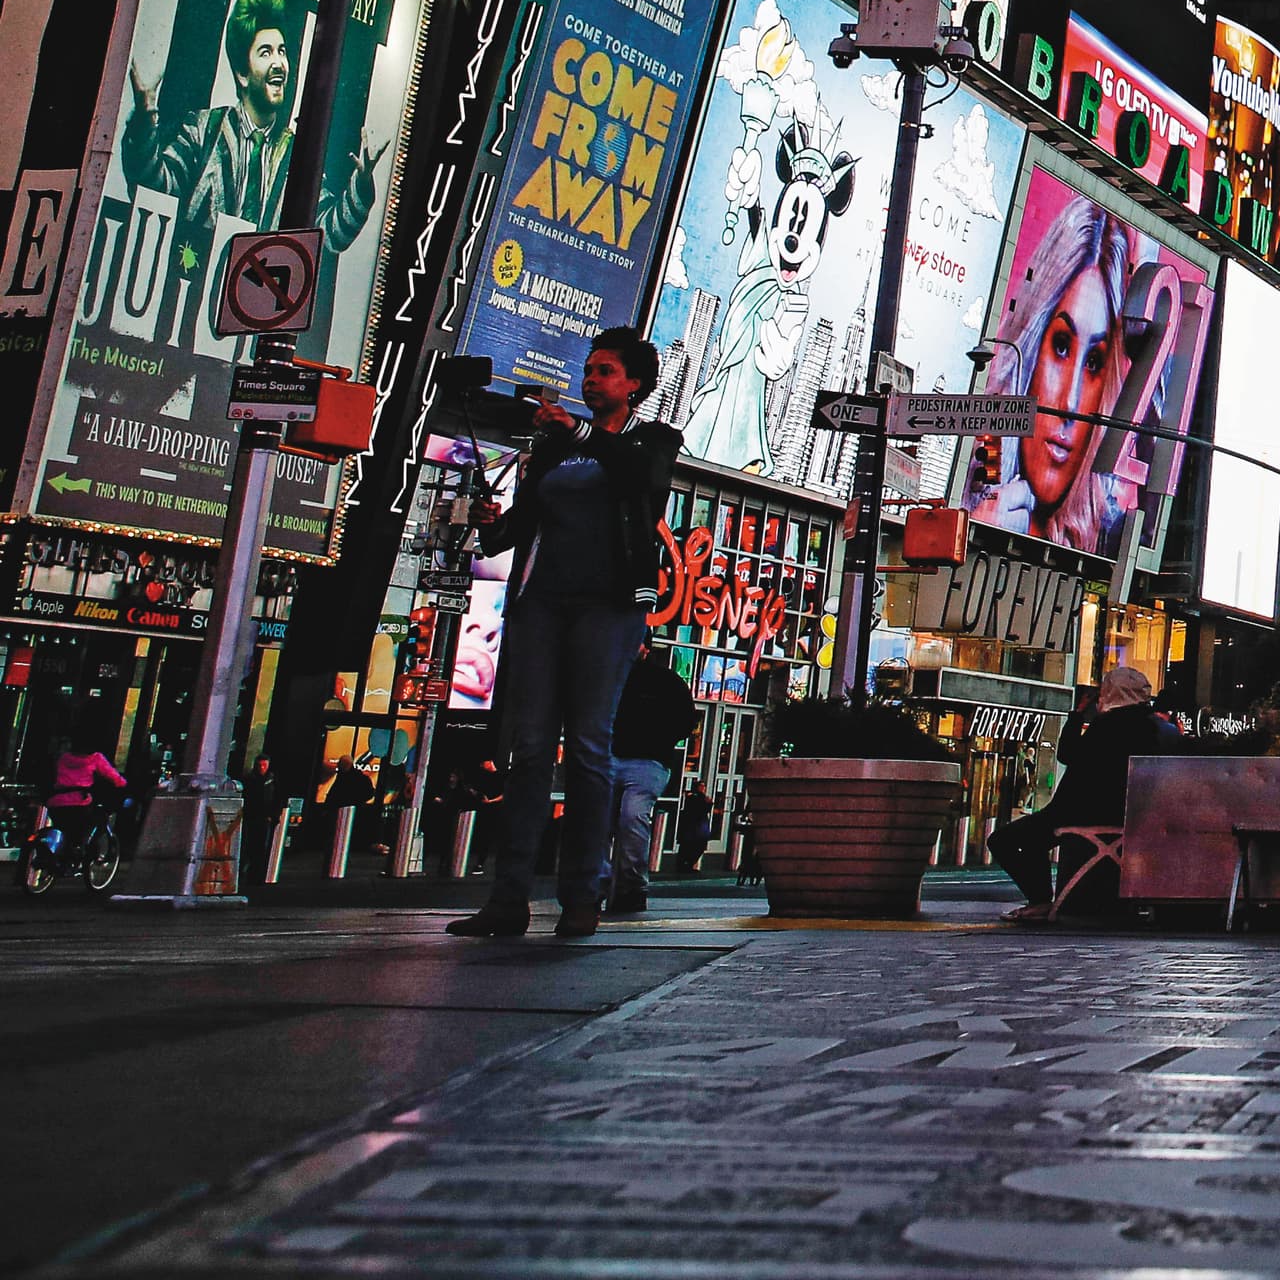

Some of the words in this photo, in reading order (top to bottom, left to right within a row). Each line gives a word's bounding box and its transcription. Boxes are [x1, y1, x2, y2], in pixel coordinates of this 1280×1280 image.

[565, 14, 602, 45] COME
[605, 35, 667, 80] TOGETHER
[668, 70, 684, 88] AT
[552, 38, 678, 143] COME
[511, 159, 654, 250] AWAY
[508, 212, 525, 228] THE
[527, 218, 584, 250] REMARKABLE
[586, 242, 607, 259] TRUE
[608, 250, 635, 270] STORY
[931, 251, 966, 283] store
[530, 273, 604, 320] MASTERPIECE!
[919, 278, 962, 307] SQUARE
[69, 337, 101, 364] The
[238, 380, 267, 389] Times
[269, 381, 306, 392] Square
[830, 404, 862, 420] ONE
[907, 399, 969, 413] PEDESTRIAN
[973, 400, 1001, 413] FLOW
[1003, 401, 1030, 414] ZONE
[961, 416, 987, 430] KEEP
[989, 417, 1028, 431] MOVING
[103, 421, 231, 467] JAW-DROPPING
[95, 481, 119, 499] THIS
[119, 485, 140, 503] WAY
[156, 490, 173, 508] THE
[282, 515, 328, 536] BROADWAY
[34, 600, 65, 614] Apple
[74, 601, 119, 620] Nikon
[127, 607, 180, 628] Canon
[970, 706, 1024, 739] FOREVER
